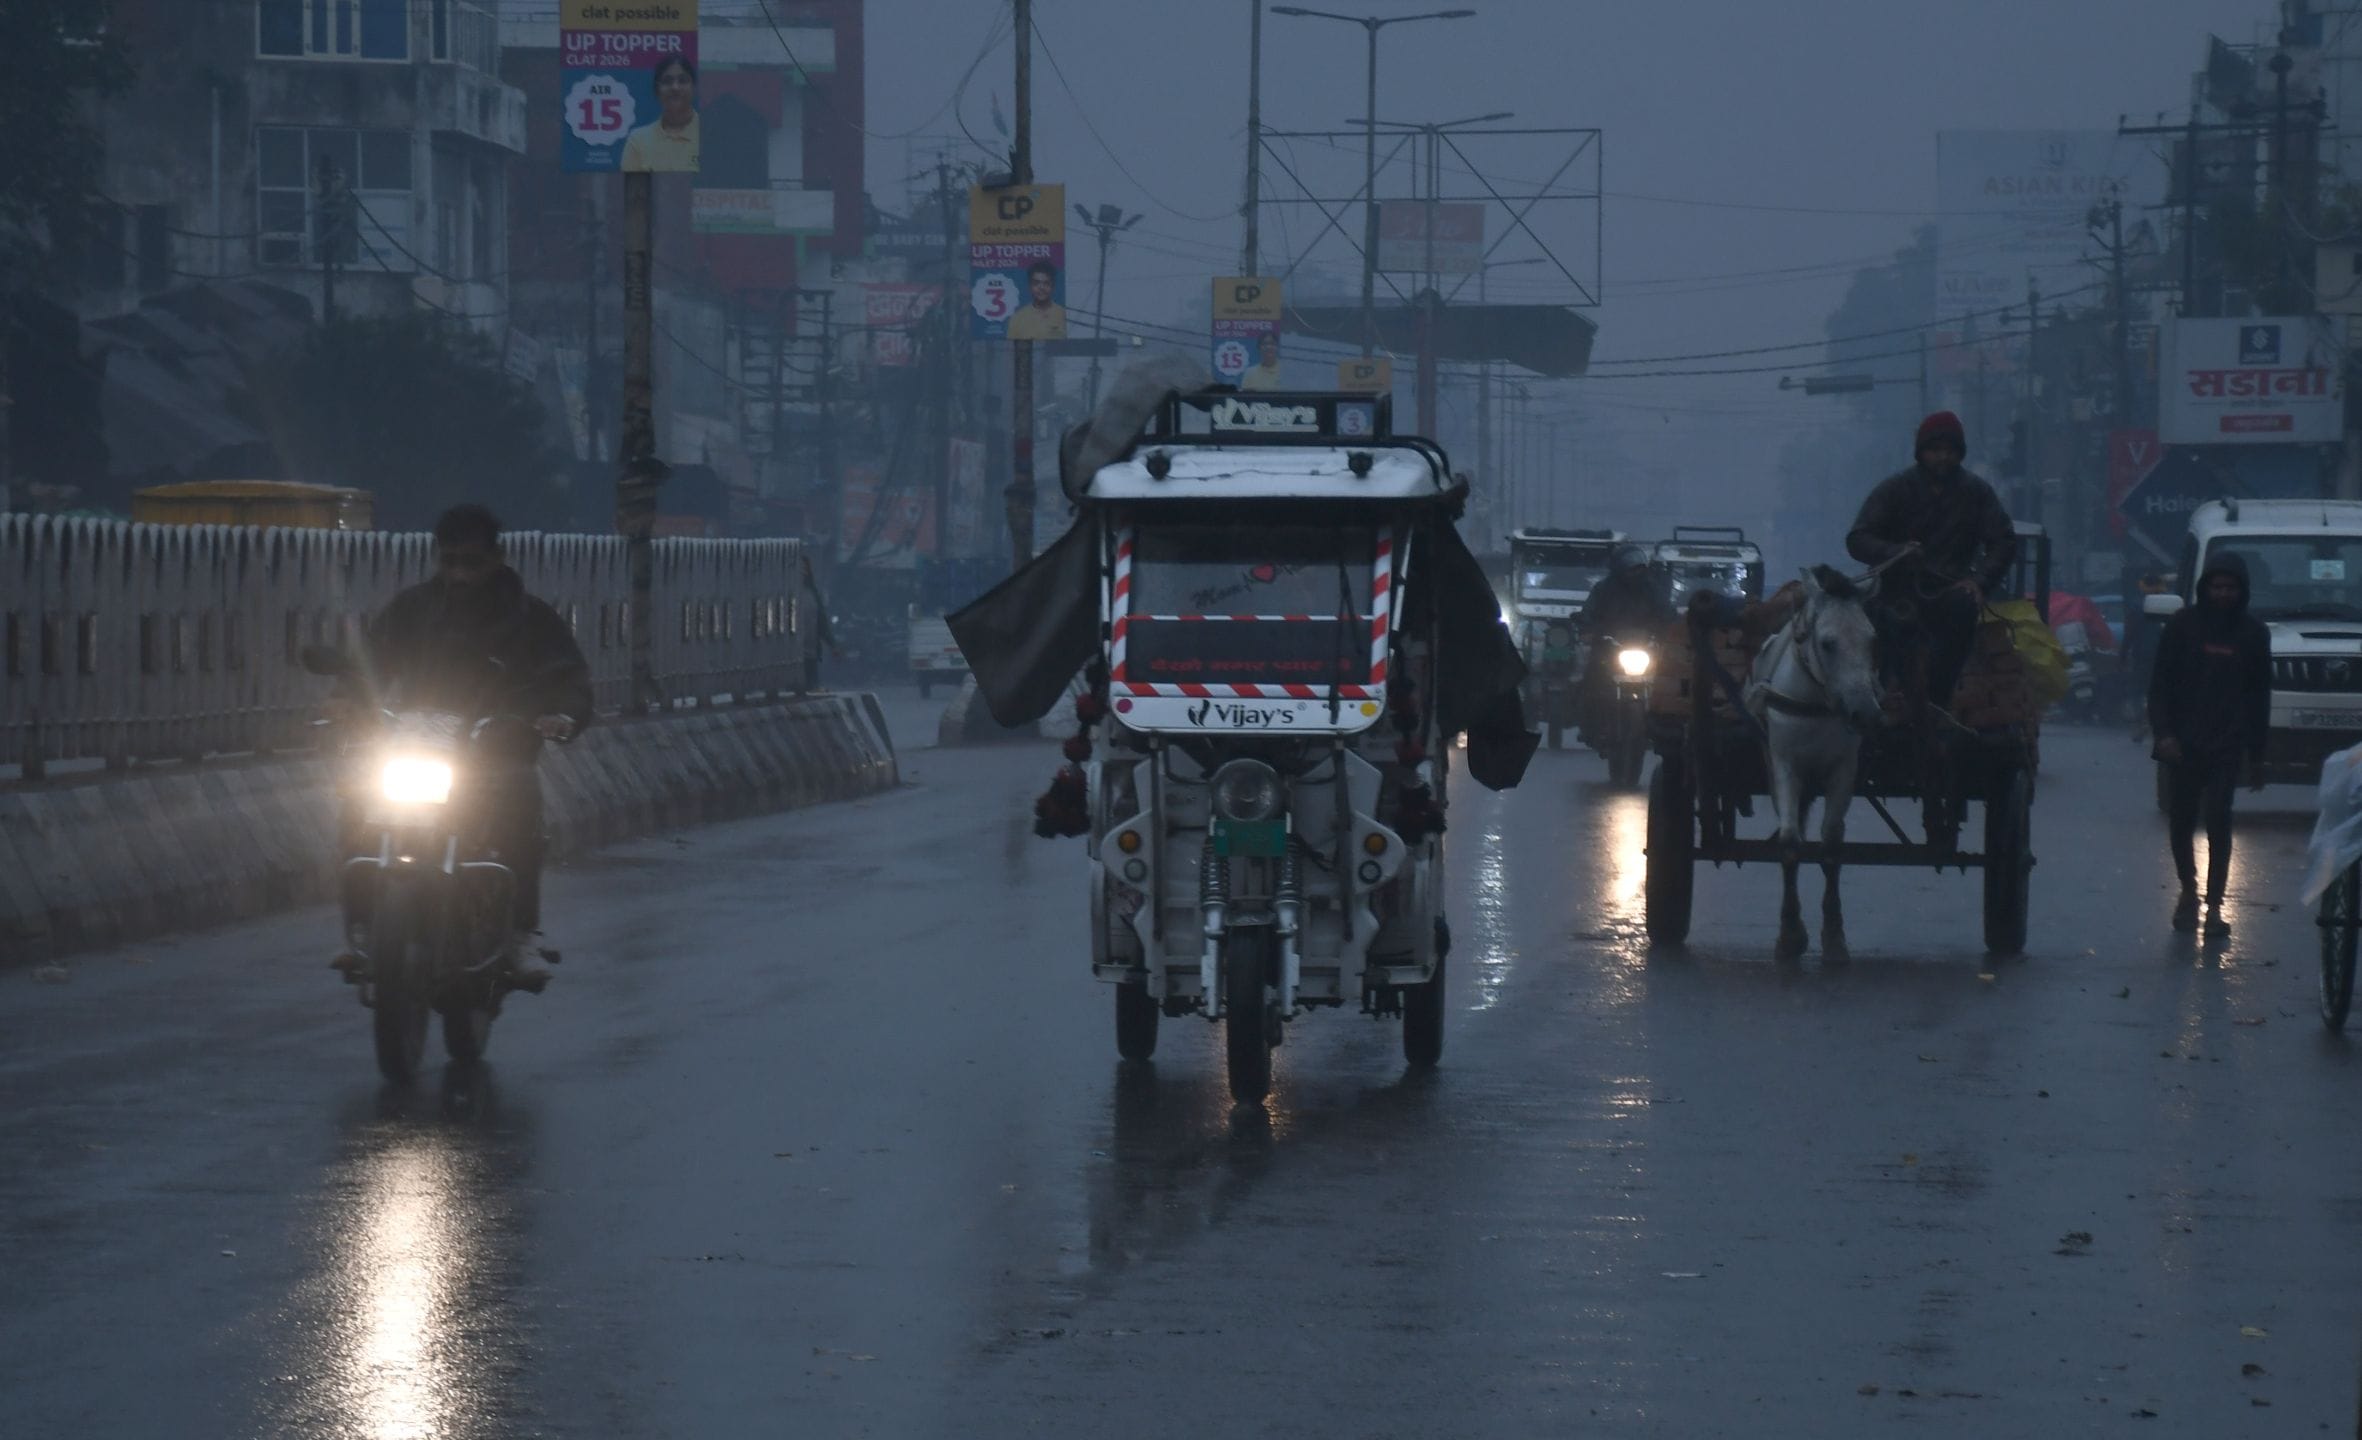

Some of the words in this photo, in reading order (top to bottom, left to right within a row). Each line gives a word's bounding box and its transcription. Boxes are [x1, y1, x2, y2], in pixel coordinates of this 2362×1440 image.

[582, 6, 610, 19] clat
[615, 6, 680, 22] possible
[566, 33, 596, 51] UP
[601, 33, 682, 52] TOPPER
[566, 54, 597, 65] CLAT
[600, 54, 630, 66] 2026
[590, 85, 611, 95] AIR
[578, 98, 622, 131] 15
[1984, 176, 2063, 195] ASIAN
[997, 195, 1034, 220] CP
[1005, 225, 1049, 238] possible
[972, 245, 993, 258] UP
[995, 245, 1050, 258] TOPPER
[985, 288, 1006, 317] 3
[1235, 285, 1261, 303] CP
[1215, 320, 1231, 330] UP
[1232, 320, 1273, 331] TOPPER
[1221, 353, 1242, 369] 15
[1216, 703, 1293, 727] Vijay's
